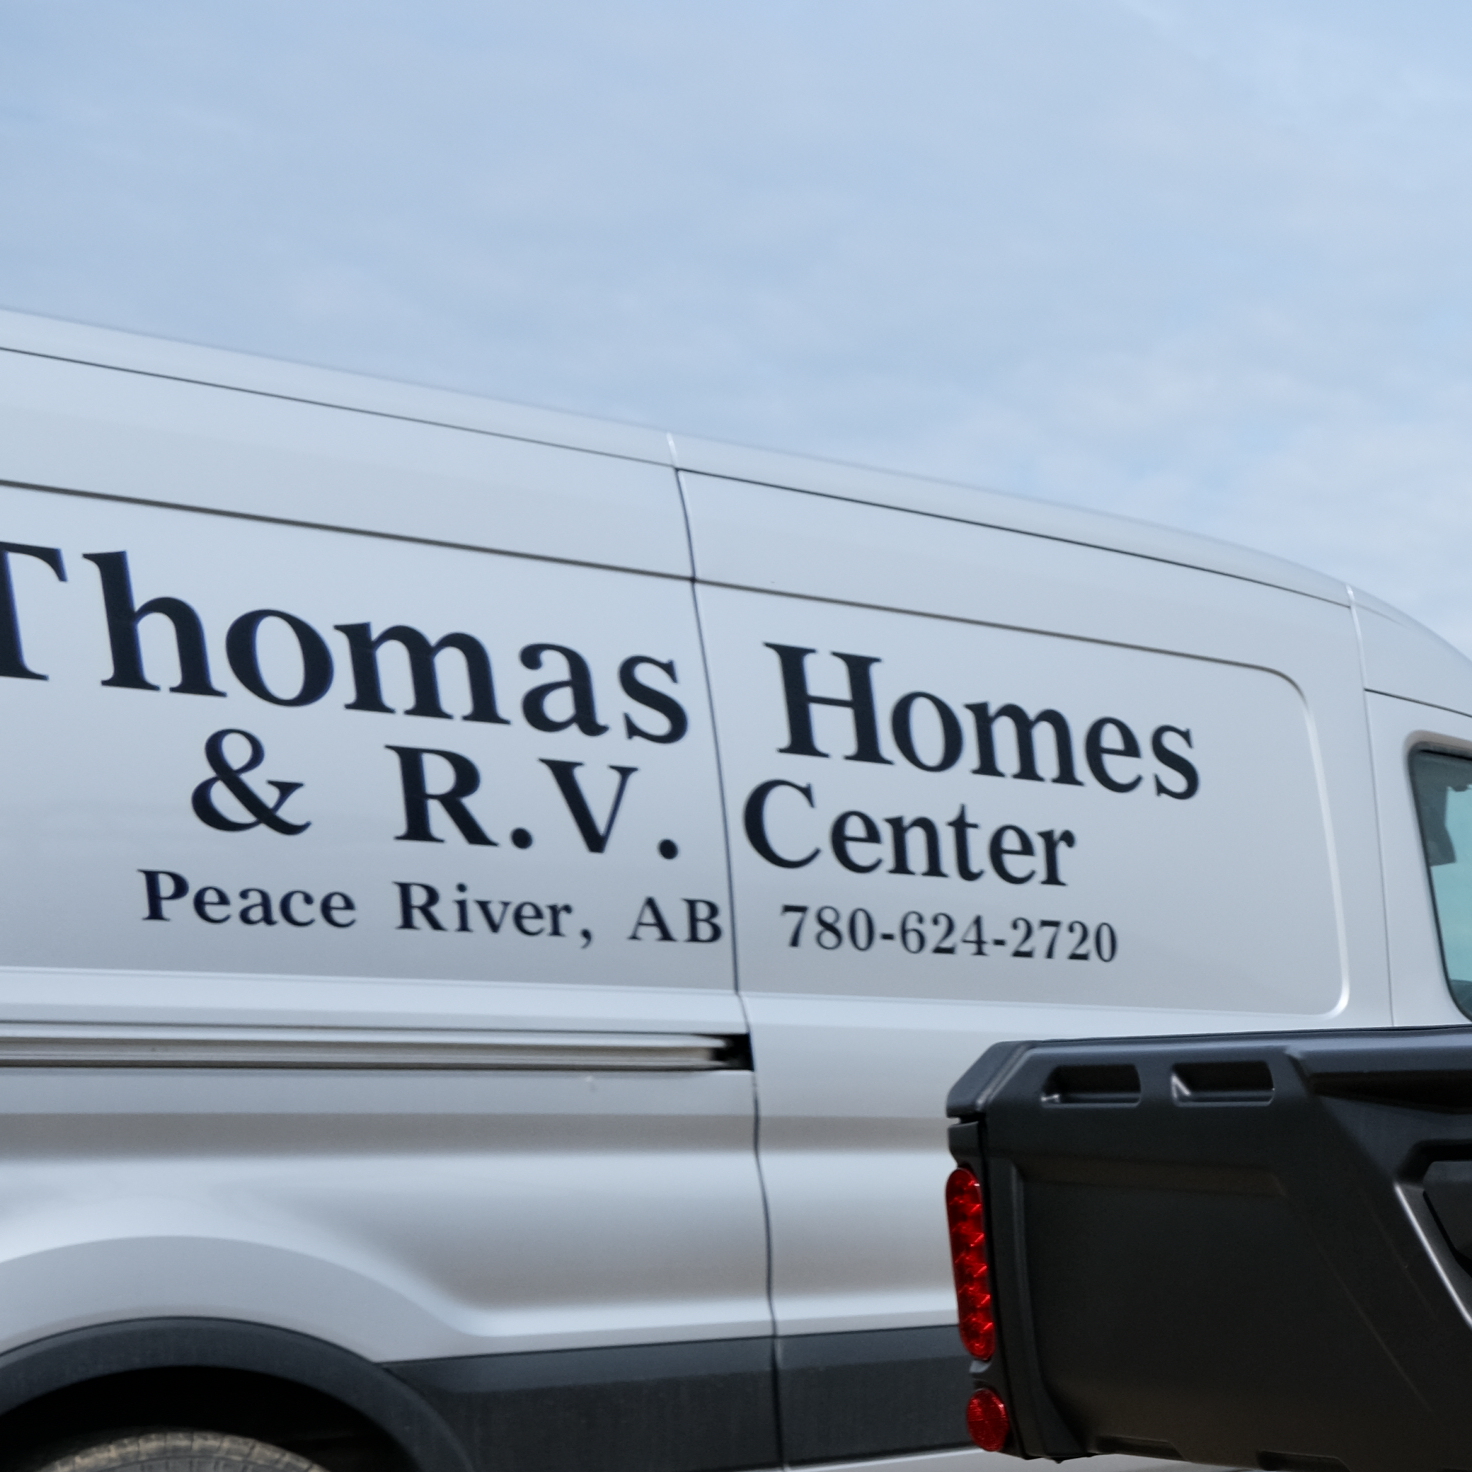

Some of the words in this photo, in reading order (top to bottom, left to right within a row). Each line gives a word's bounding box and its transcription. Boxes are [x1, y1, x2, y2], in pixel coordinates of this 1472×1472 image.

[763, 641, 1200, 801] Homes
[190, 727, 313, 837] &
[383, 743, 680, 861] R.V.
[742, 778, 1077, 888] Center
[137, 868, 357, 930] Peace
[392, 880, 593, 950] River,
[627, 895, 724, 945] AB
[780, 903, 1118, 964] 780-624-2720
